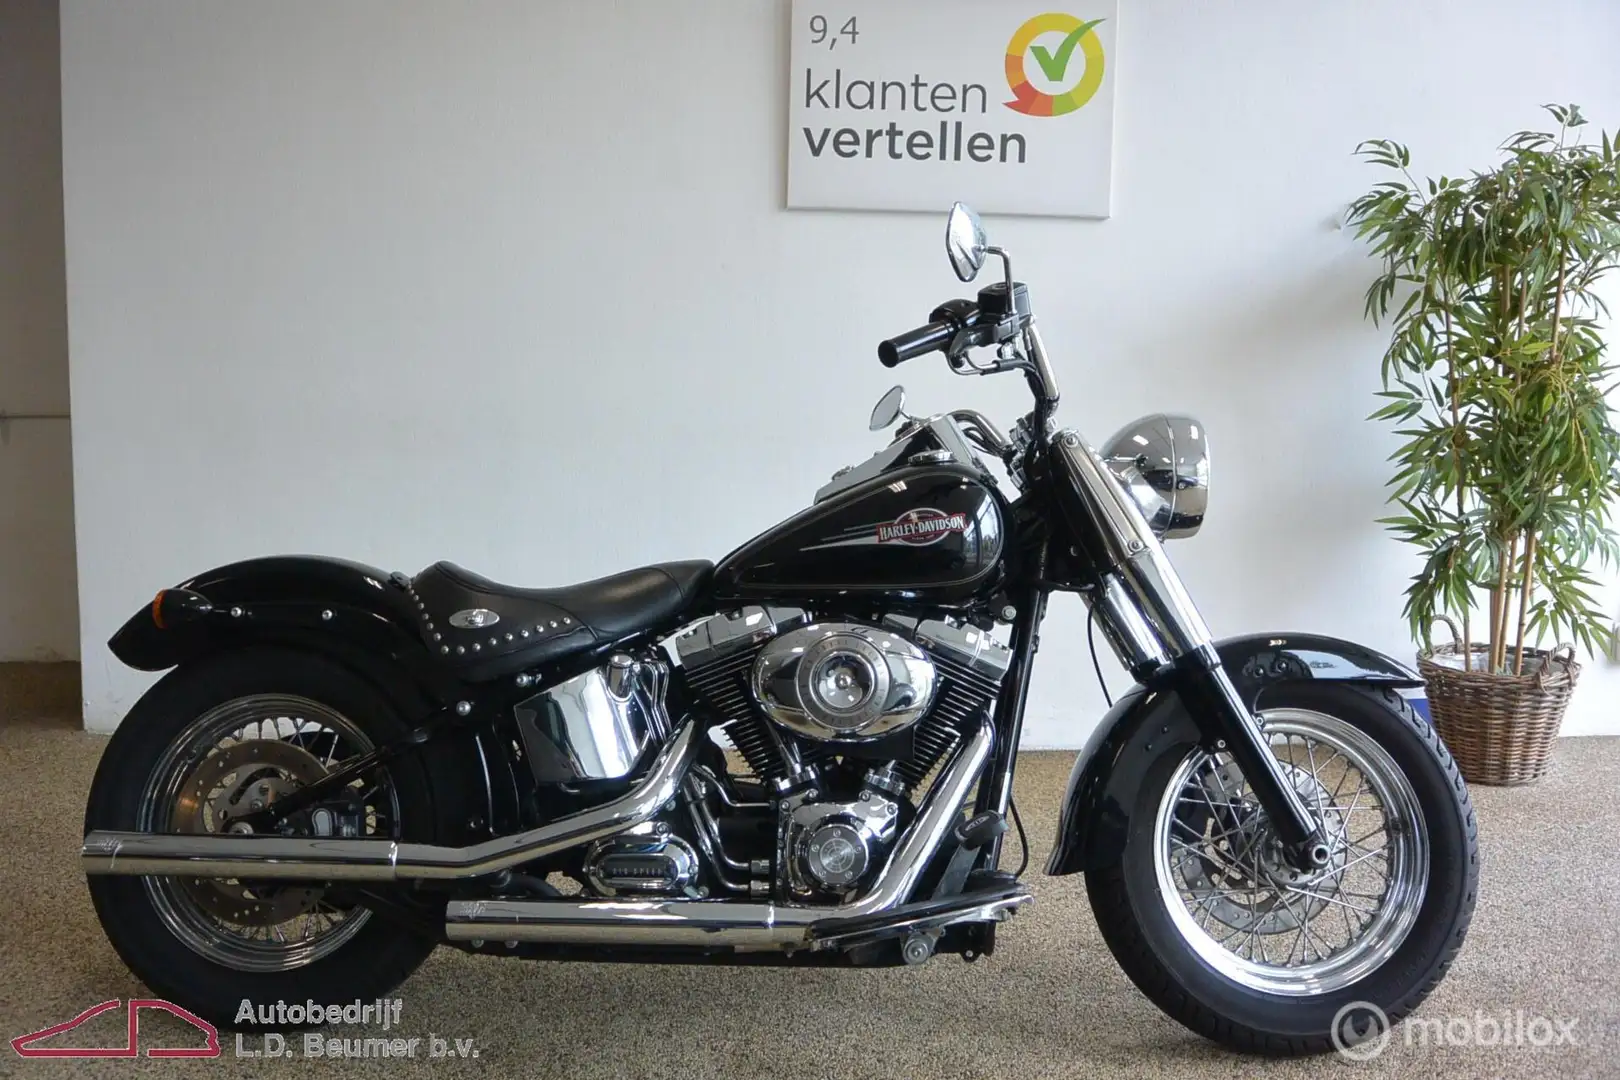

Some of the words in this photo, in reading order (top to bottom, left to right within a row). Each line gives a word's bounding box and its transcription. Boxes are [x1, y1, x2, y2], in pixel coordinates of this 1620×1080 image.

[809, 15, 859, 50] 9,4
[805, 68, 987, 114] klanten
[803, 120, 1027, 164] vertellen
